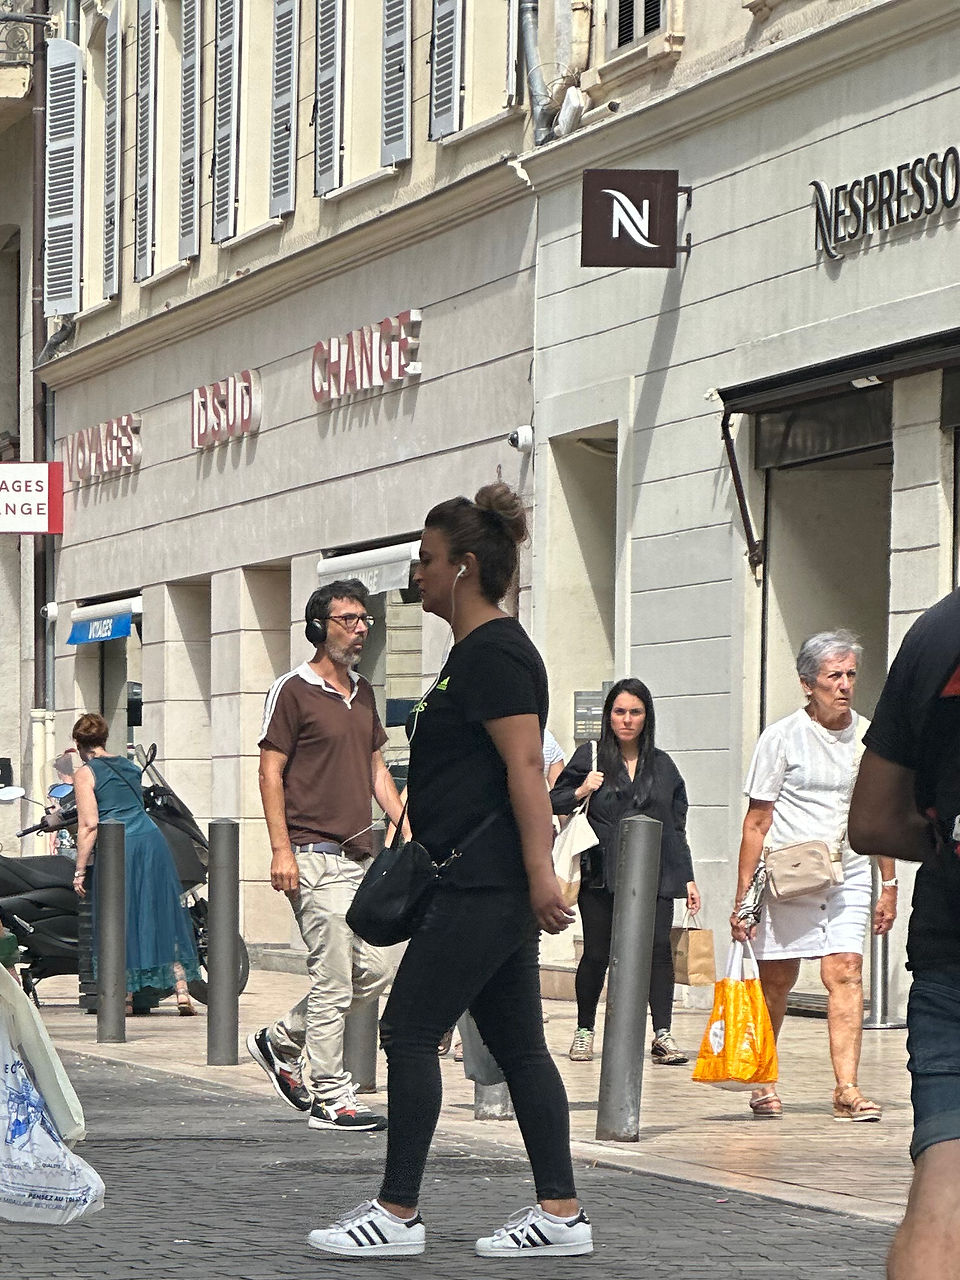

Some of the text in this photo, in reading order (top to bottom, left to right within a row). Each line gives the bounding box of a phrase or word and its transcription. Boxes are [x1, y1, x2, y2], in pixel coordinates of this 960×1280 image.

[600, 189, 661, 248] N
[809, 146, 959, 259] NESPRESSO
[312, 309, 422, 404] CHANGE
